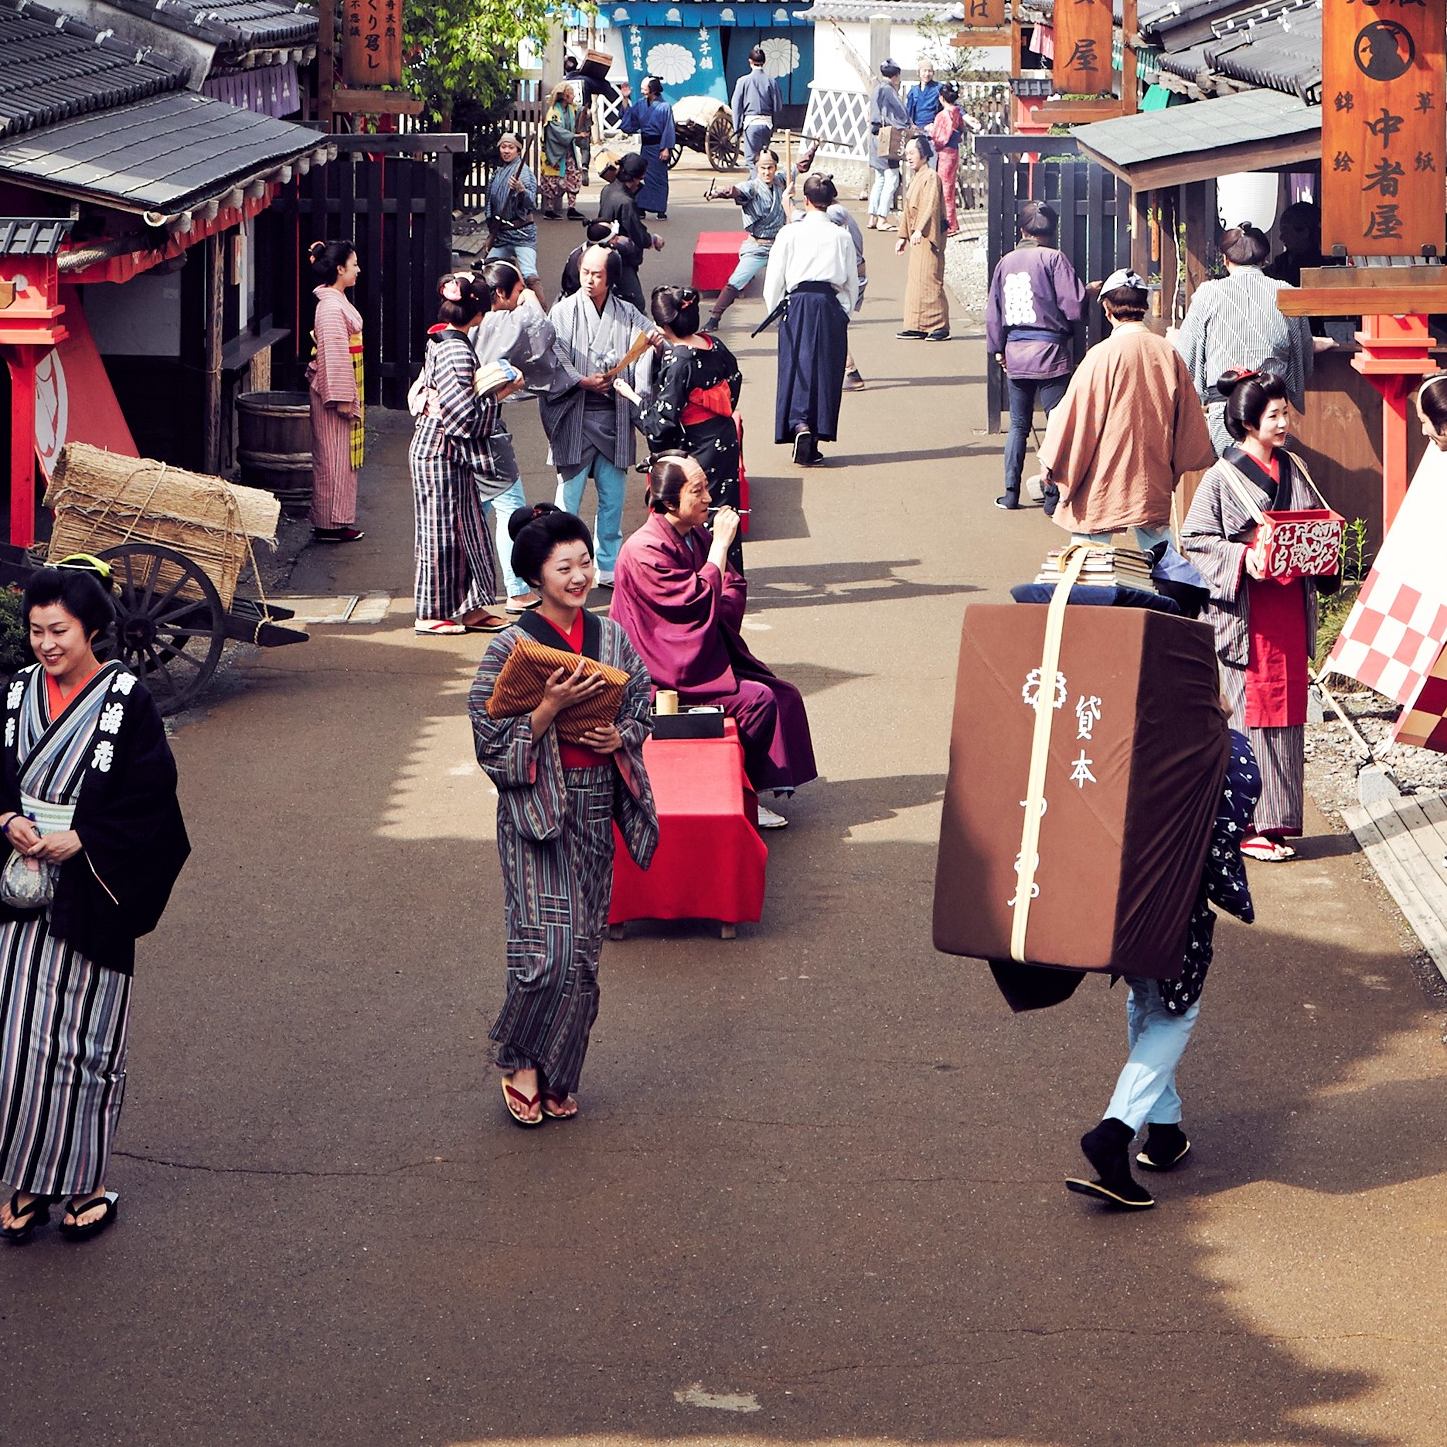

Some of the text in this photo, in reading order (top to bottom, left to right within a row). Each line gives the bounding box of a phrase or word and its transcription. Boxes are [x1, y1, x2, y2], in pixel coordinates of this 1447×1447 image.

[1333, 90, 1355, 174] 錦絵
[1362, 108, 1406, 241] 中者屋
[1413, 90, 1437, 174] 草紙
[4, 664, 36, 748] 海老
[91, 671, 138, 773] 角海老
[1069, 695, 1102, 789] 貸本
